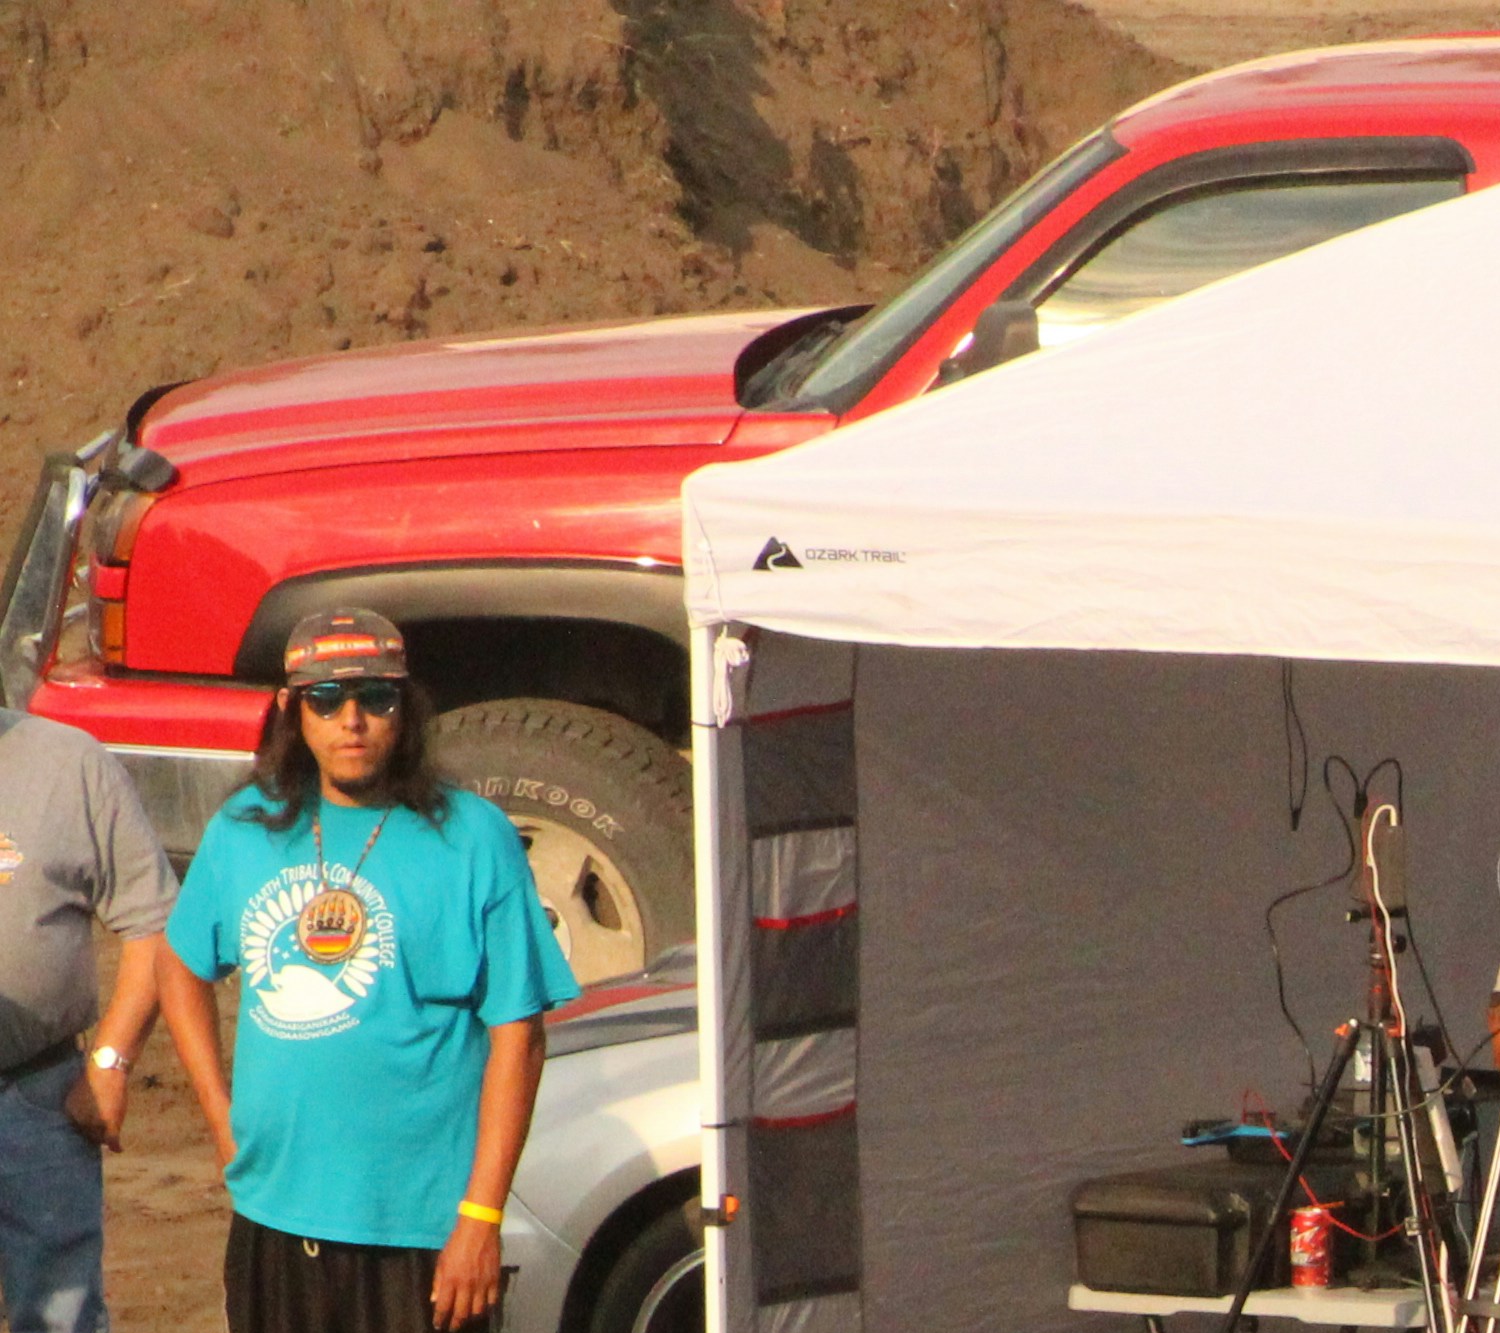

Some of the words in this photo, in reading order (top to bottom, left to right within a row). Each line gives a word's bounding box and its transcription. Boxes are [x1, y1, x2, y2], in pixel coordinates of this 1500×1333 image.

[248, 875, 281, 910] EARTH
[280, 863, 319, 885] TRIBAL
[375, 911, 396, 969] COLLEGE
